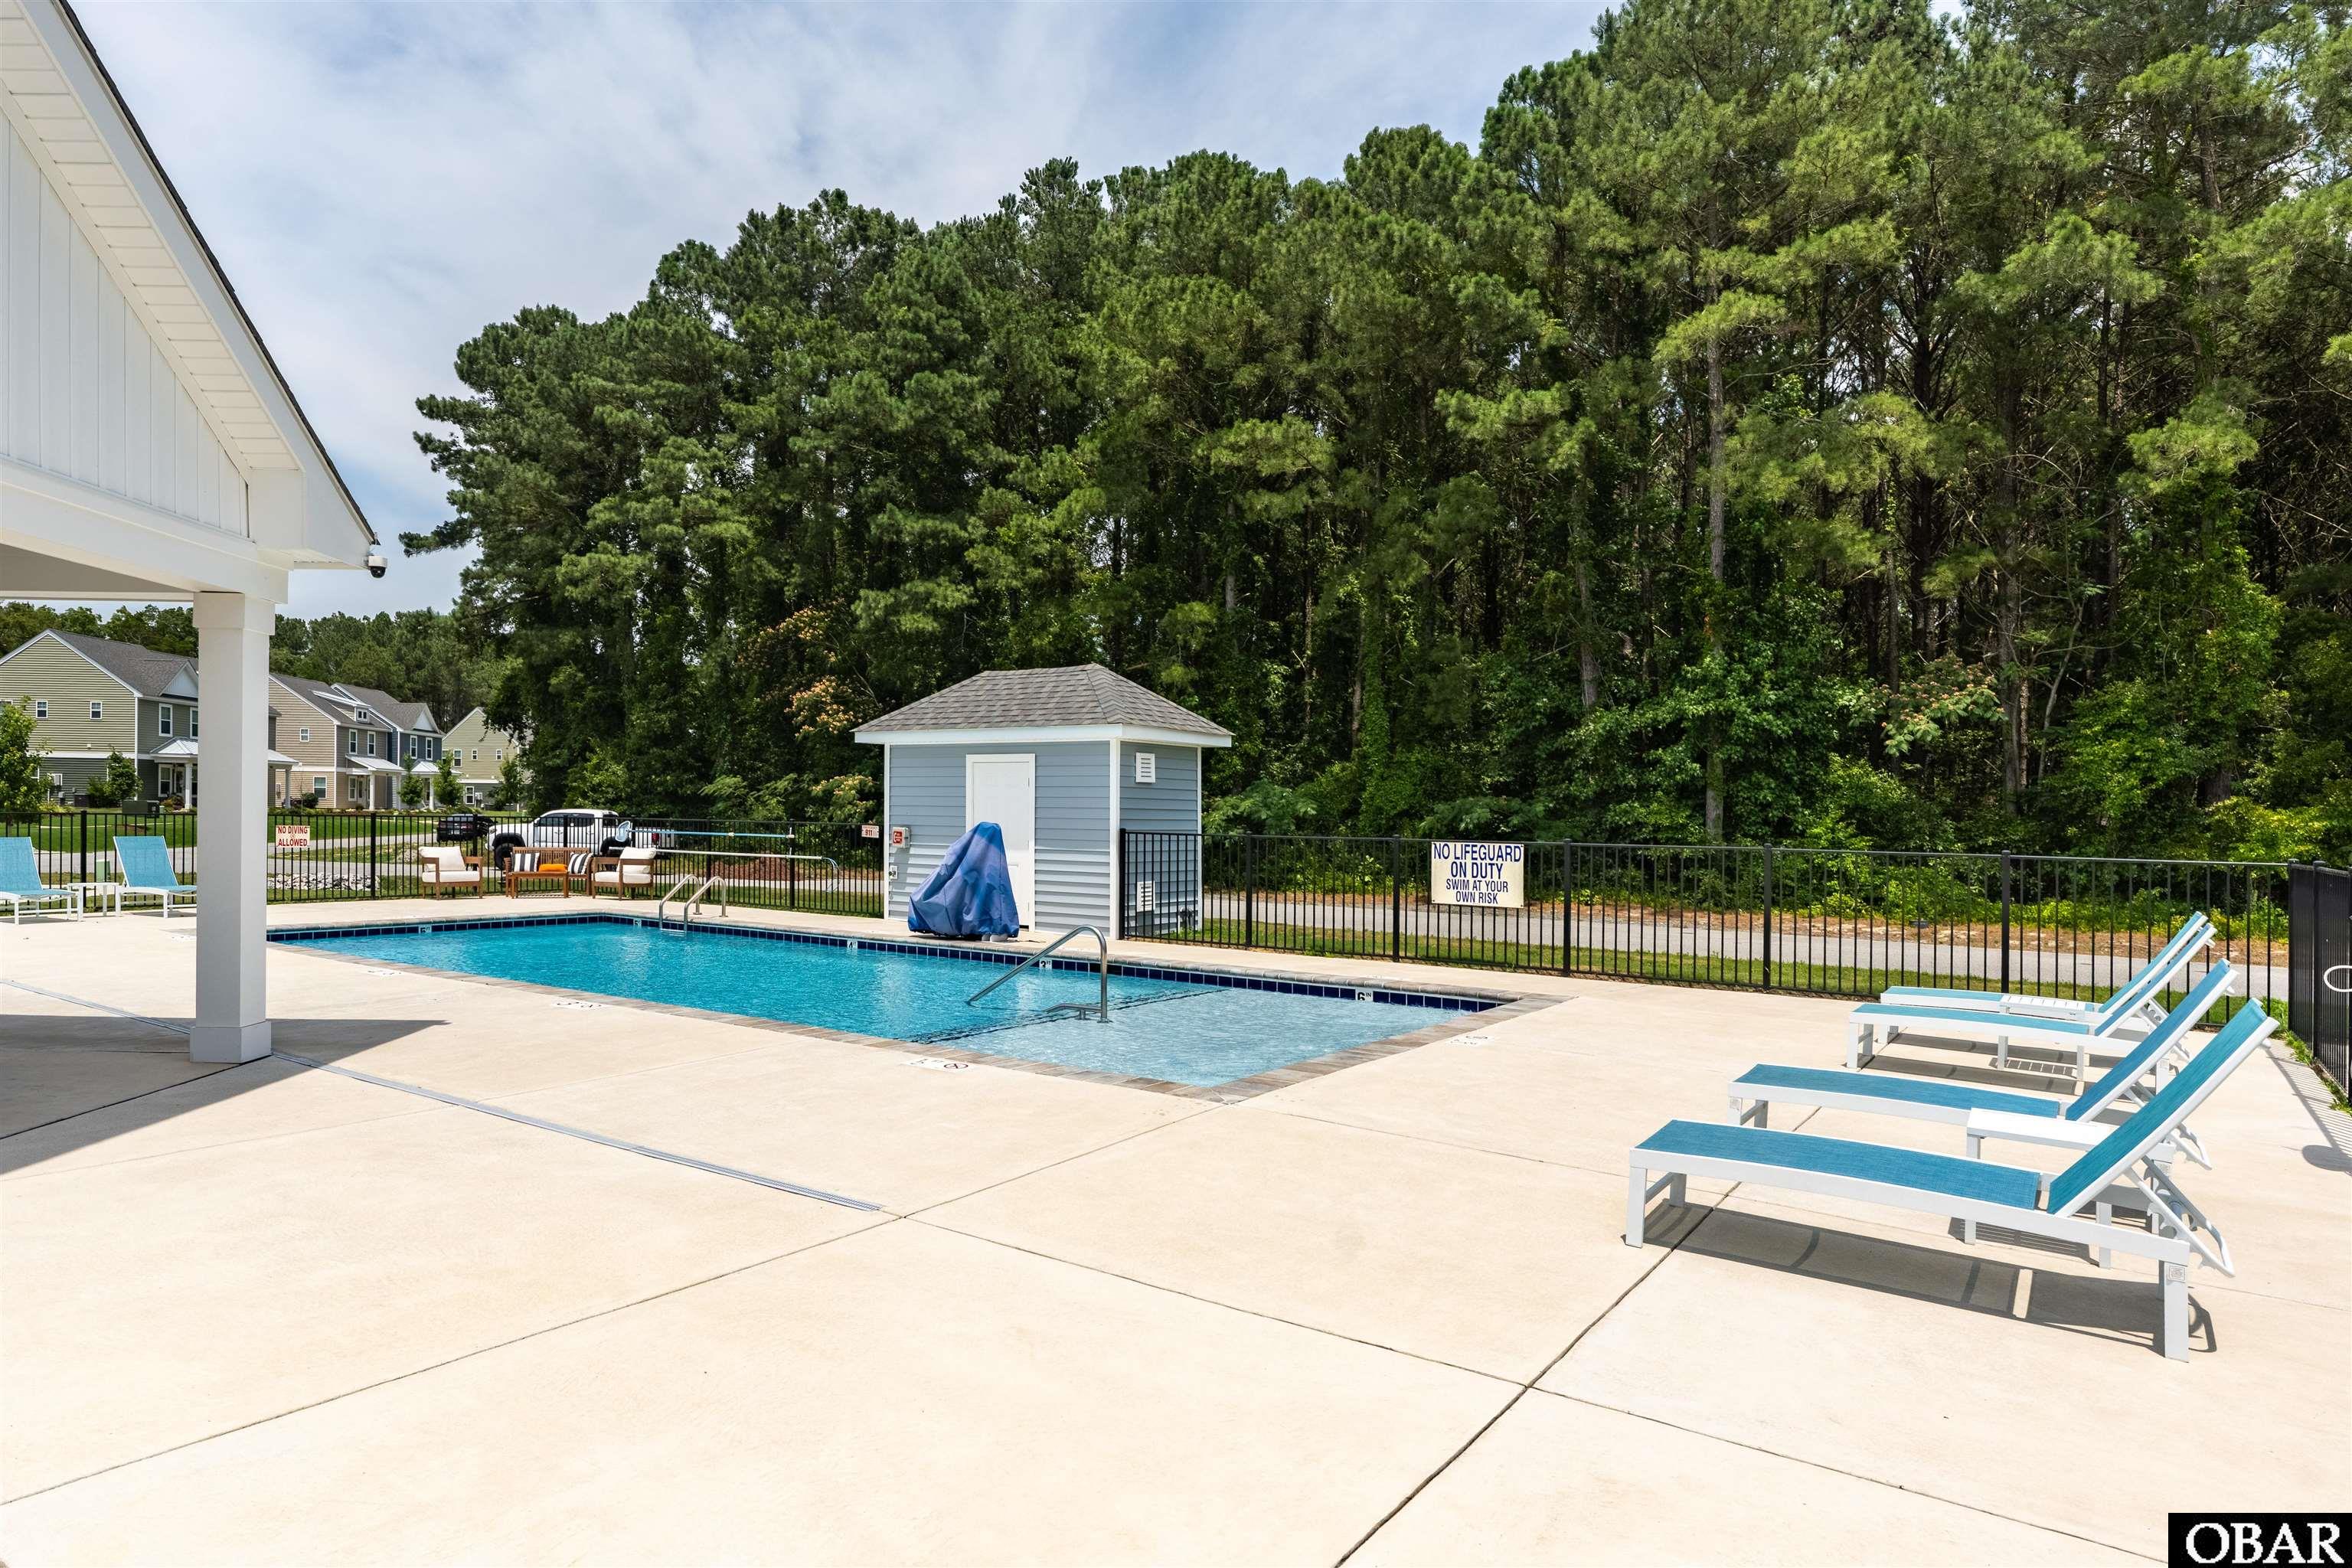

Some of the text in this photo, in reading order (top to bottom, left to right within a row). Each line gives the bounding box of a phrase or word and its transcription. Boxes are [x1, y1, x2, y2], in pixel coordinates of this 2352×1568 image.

[278, 838, 308, 847] ALLOWED
[1434, 843, 1521, 862] NO LIFEGUARD
[1451, 861, 1504, 879] ON DUTY
[1446, 878, 1508, 893] SWIM AT YOUR
[1455, 890, 1498, 904] OWN RISK
